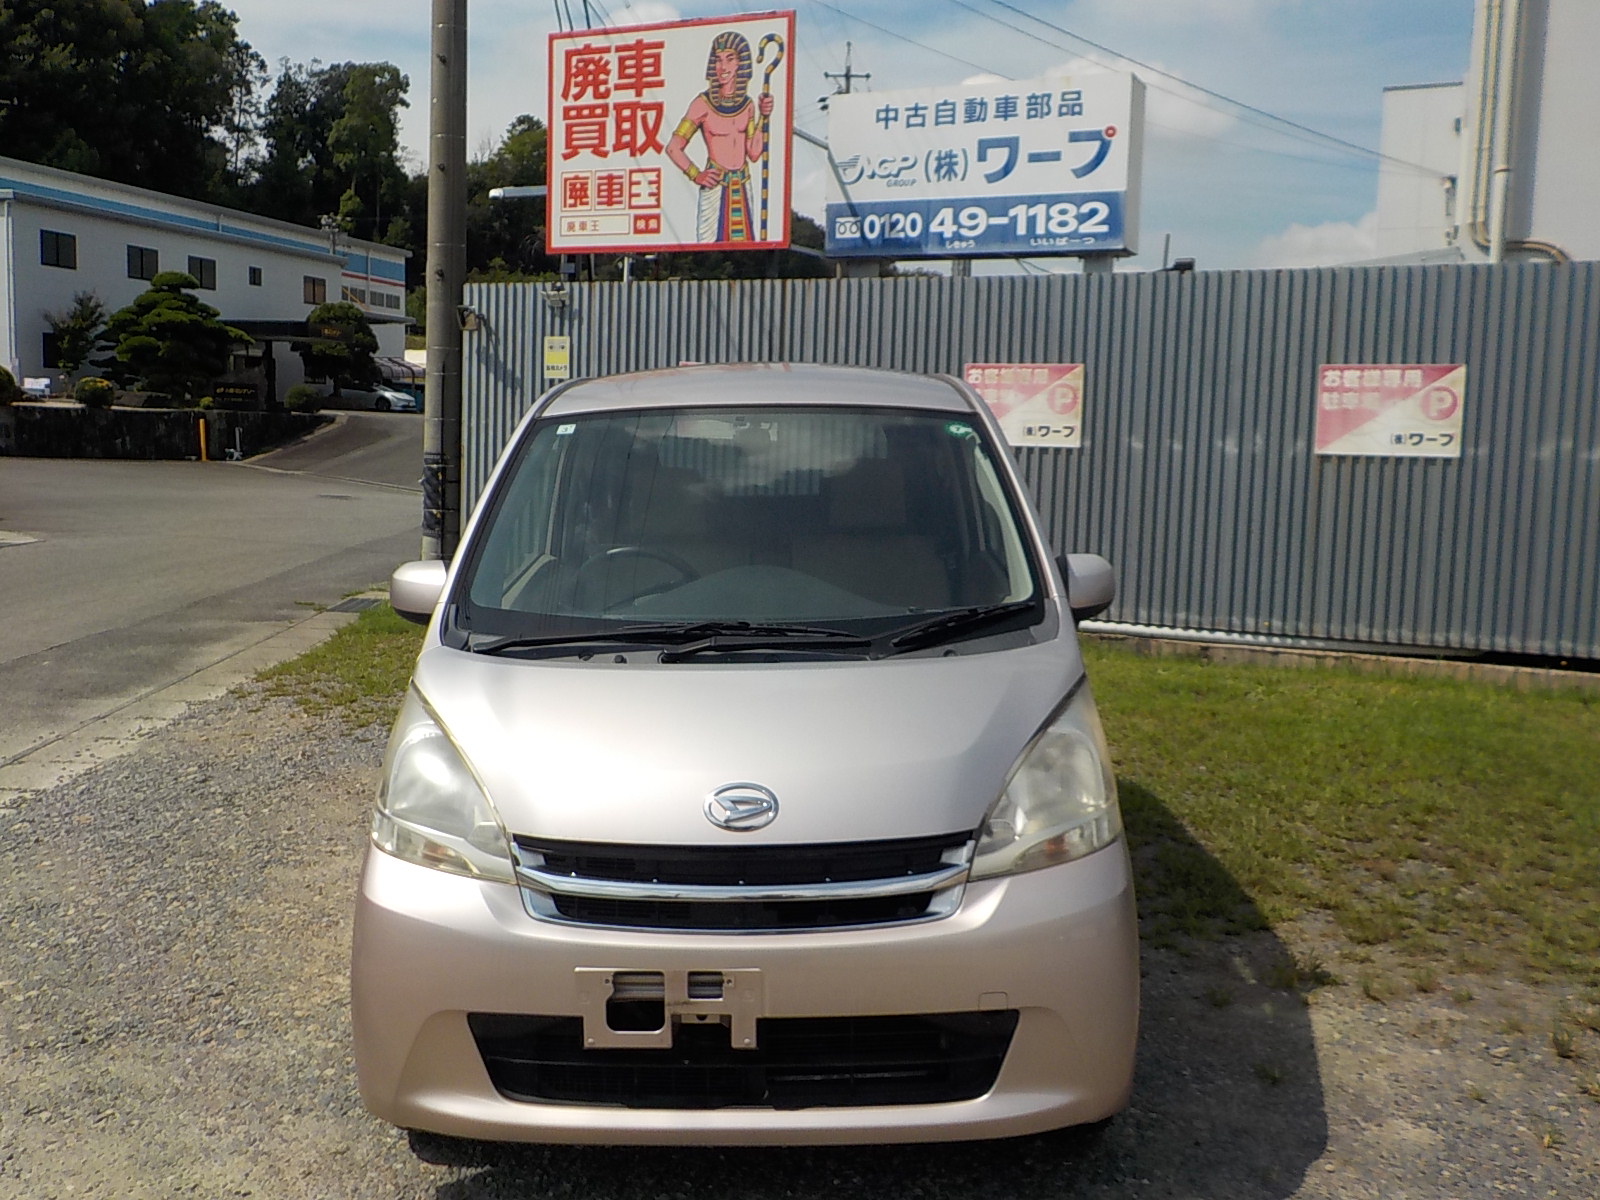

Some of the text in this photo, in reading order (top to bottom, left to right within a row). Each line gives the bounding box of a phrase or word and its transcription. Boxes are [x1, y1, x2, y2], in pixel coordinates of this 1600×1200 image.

[561, 38, 665, 102] 廃車
[875, 89, 1084, 130] 中古自動車部品
[561, 100, 665, 161] 買取
[562, 170, 660, 209] 廃車王
[863, 201, 1110, 239] 0120 49-1182
